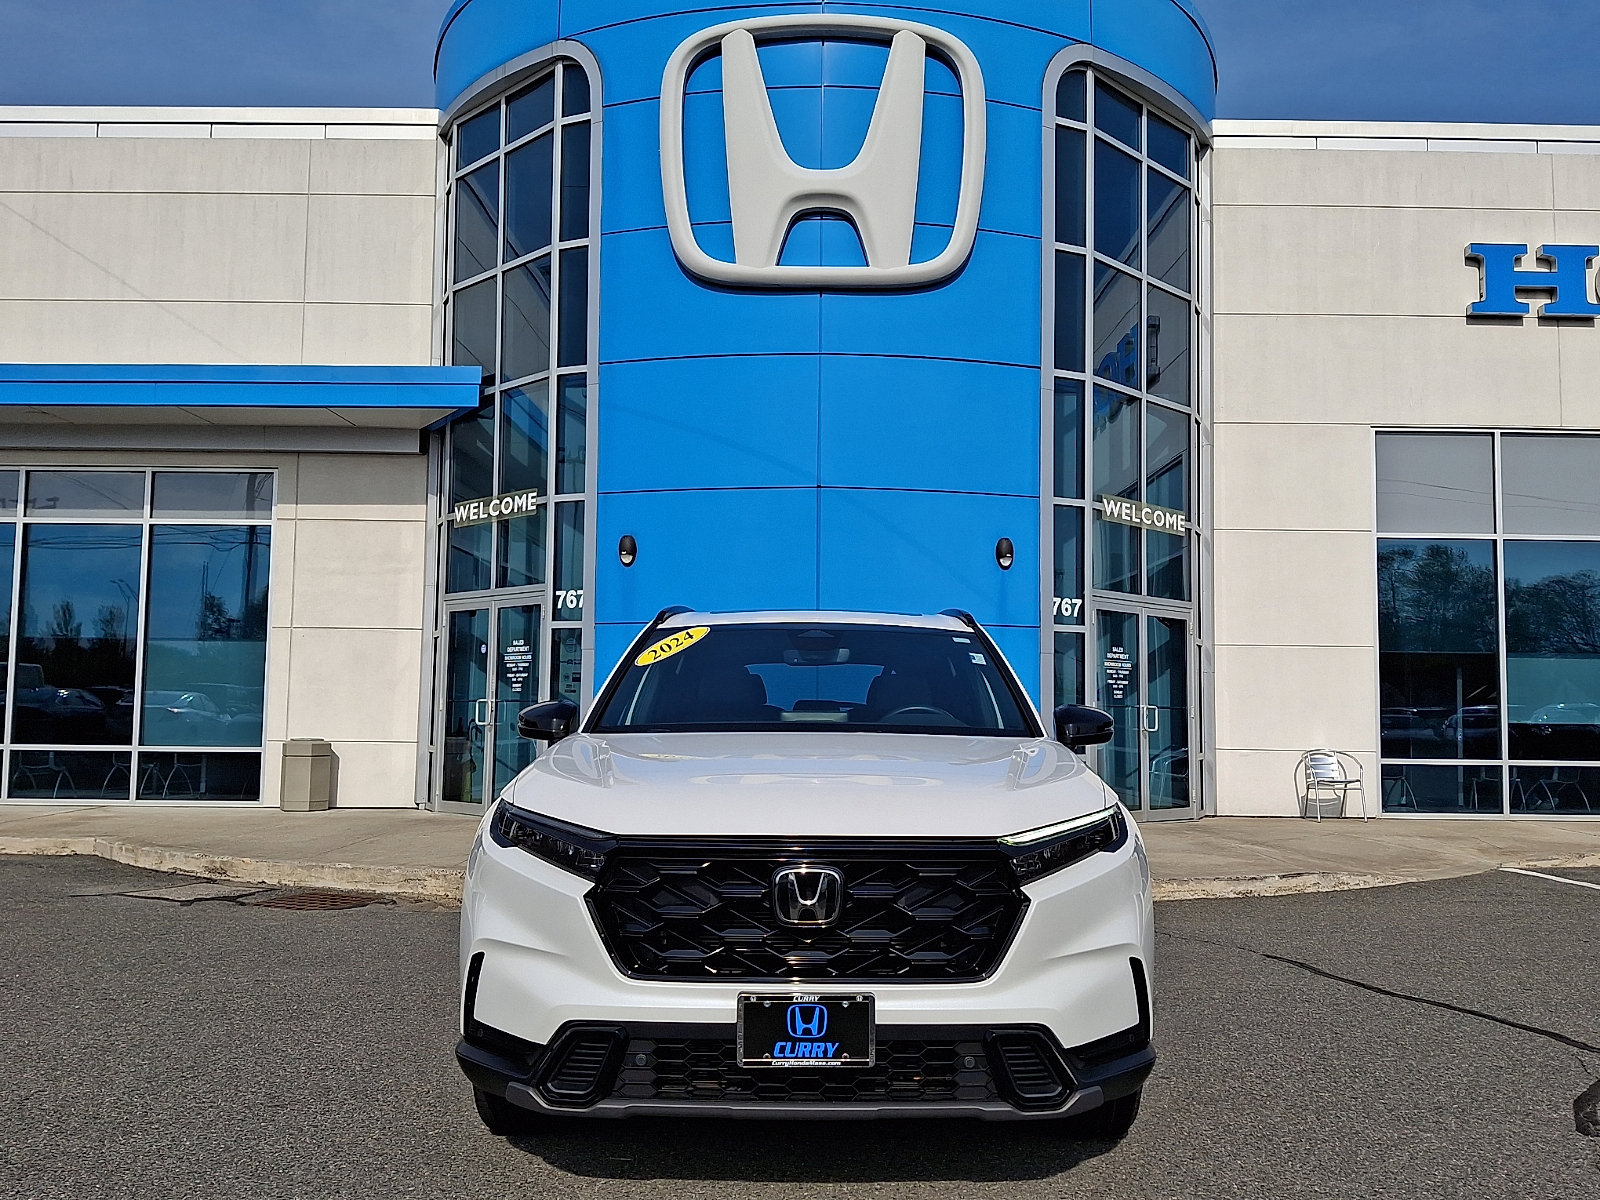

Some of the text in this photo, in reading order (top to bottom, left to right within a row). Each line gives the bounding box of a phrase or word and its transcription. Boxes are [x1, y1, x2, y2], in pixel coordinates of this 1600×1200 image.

[1464, 243, 1600, 318] H
[454, 491, 538, 523] WELCOME
[1102, 497, 1186, 533] WELCOME
[555, 589, 584, 609] 767
[1052, 597, 1083, 618] 767
[647, 630, 695, 661] 2024
[773, 1041, 840, 1058] CURRY
